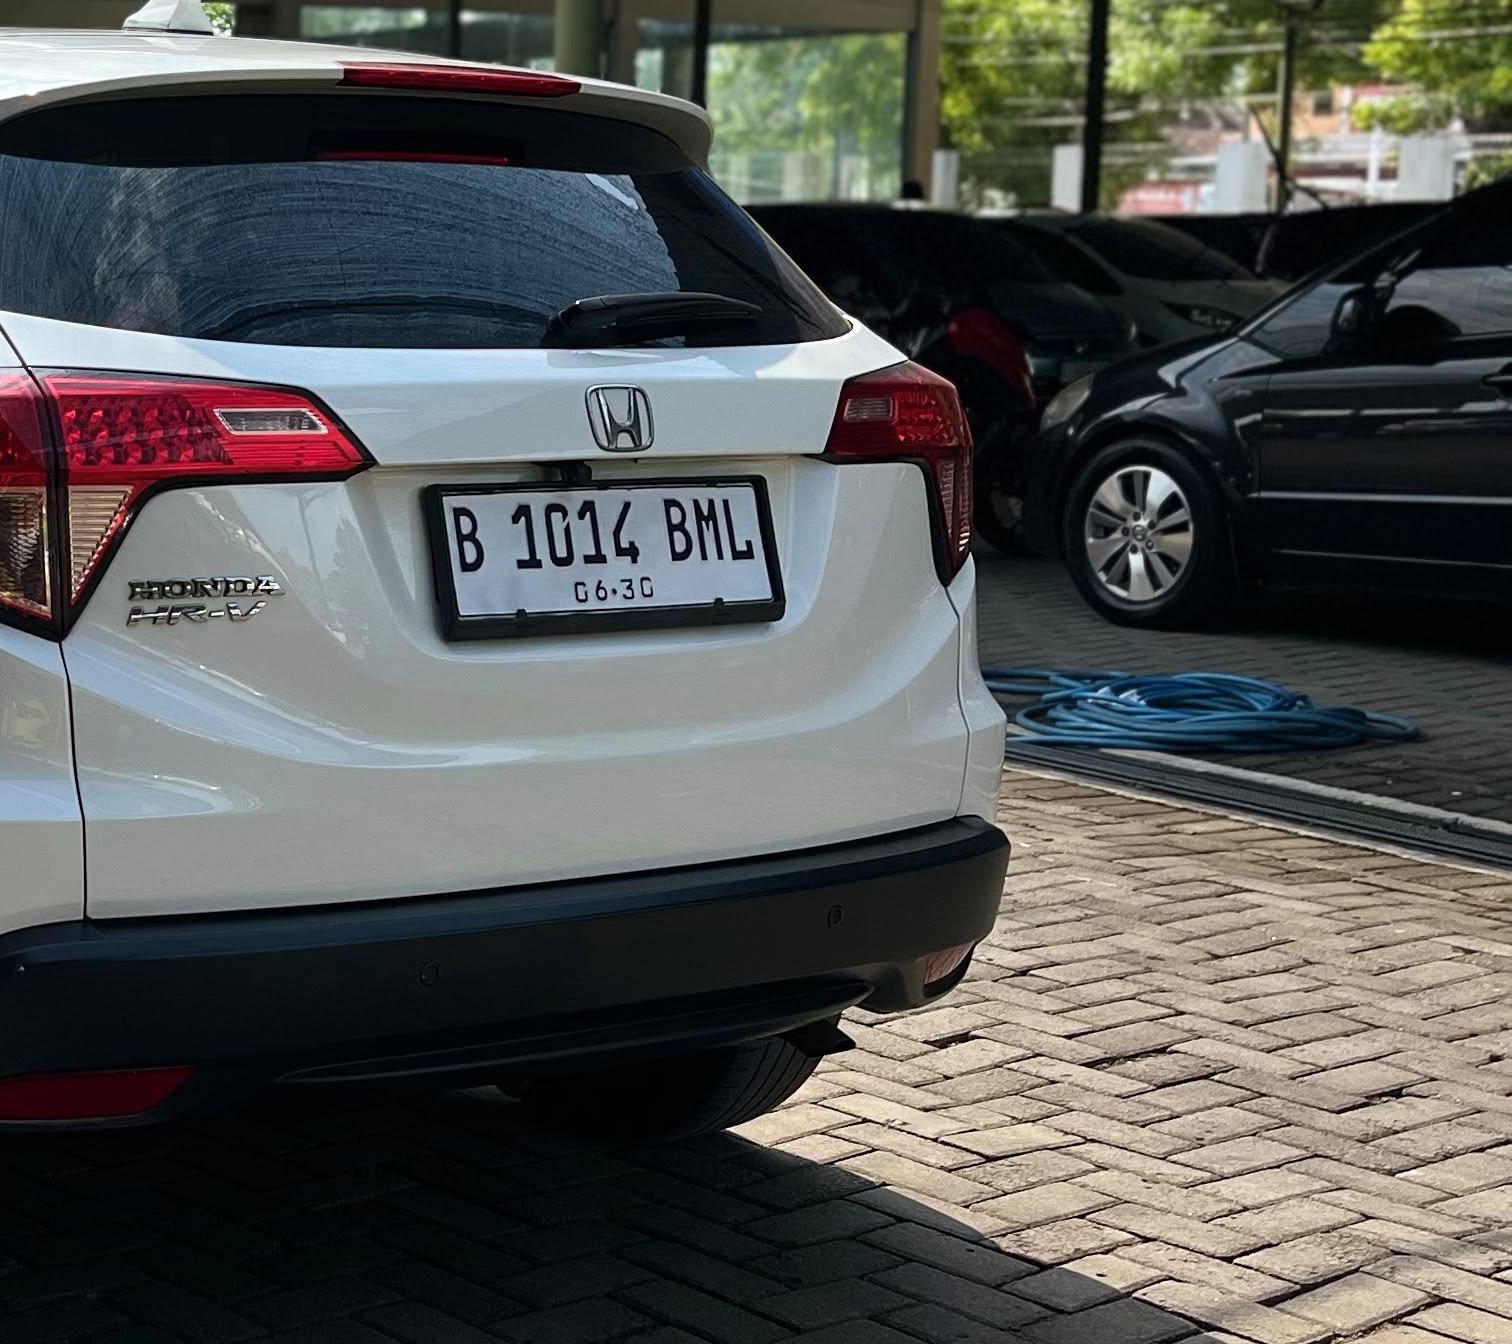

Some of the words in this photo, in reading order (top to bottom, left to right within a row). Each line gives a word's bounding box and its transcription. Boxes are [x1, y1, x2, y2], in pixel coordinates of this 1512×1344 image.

[453, 507, 485, 573] B
[511, 500, 640, 570] 1014
[663, 498, 755, 562] BML
[128, 575, 286, 601] HONDA
[126, 600, 268, 627] HR-V
